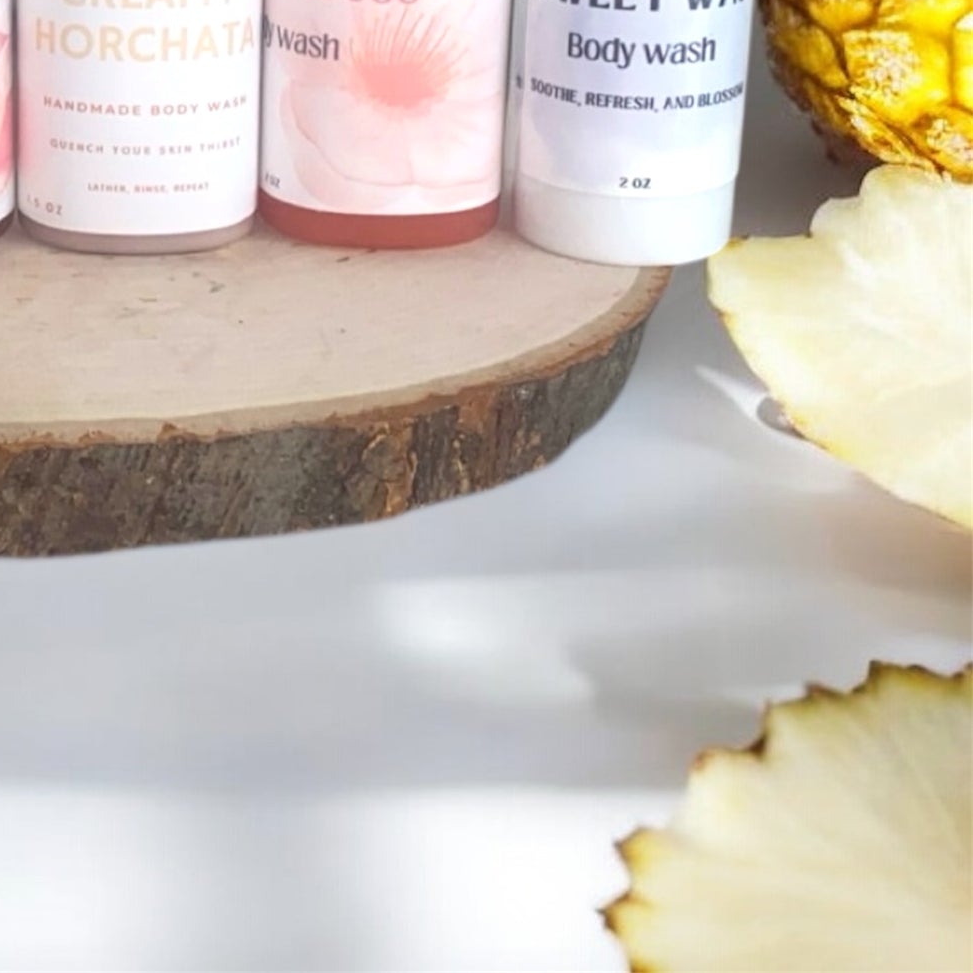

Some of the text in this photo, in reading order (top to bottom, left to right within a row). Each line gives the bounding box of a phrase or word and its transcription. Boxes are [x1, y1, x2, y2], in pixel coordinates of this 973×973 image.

[35, 17, 255, 62] HORCHATA
[277, 24, 340, 61] wash
[567, 32, 717, 69] Body wash
[43, 94, 248, 117] HANDMADE BODY WASH
[585, 92, 658, 113] REFRESH,
[663, 95, 694, 110] AND
[50, 137, 104, 154] QUENCH
[113, 145, 151, 156] YOUR
[159, 145, 192, 156] SKIN
[619, 178, 652, 189] 2 OZ
[46, 202, 63, 215] OZ
